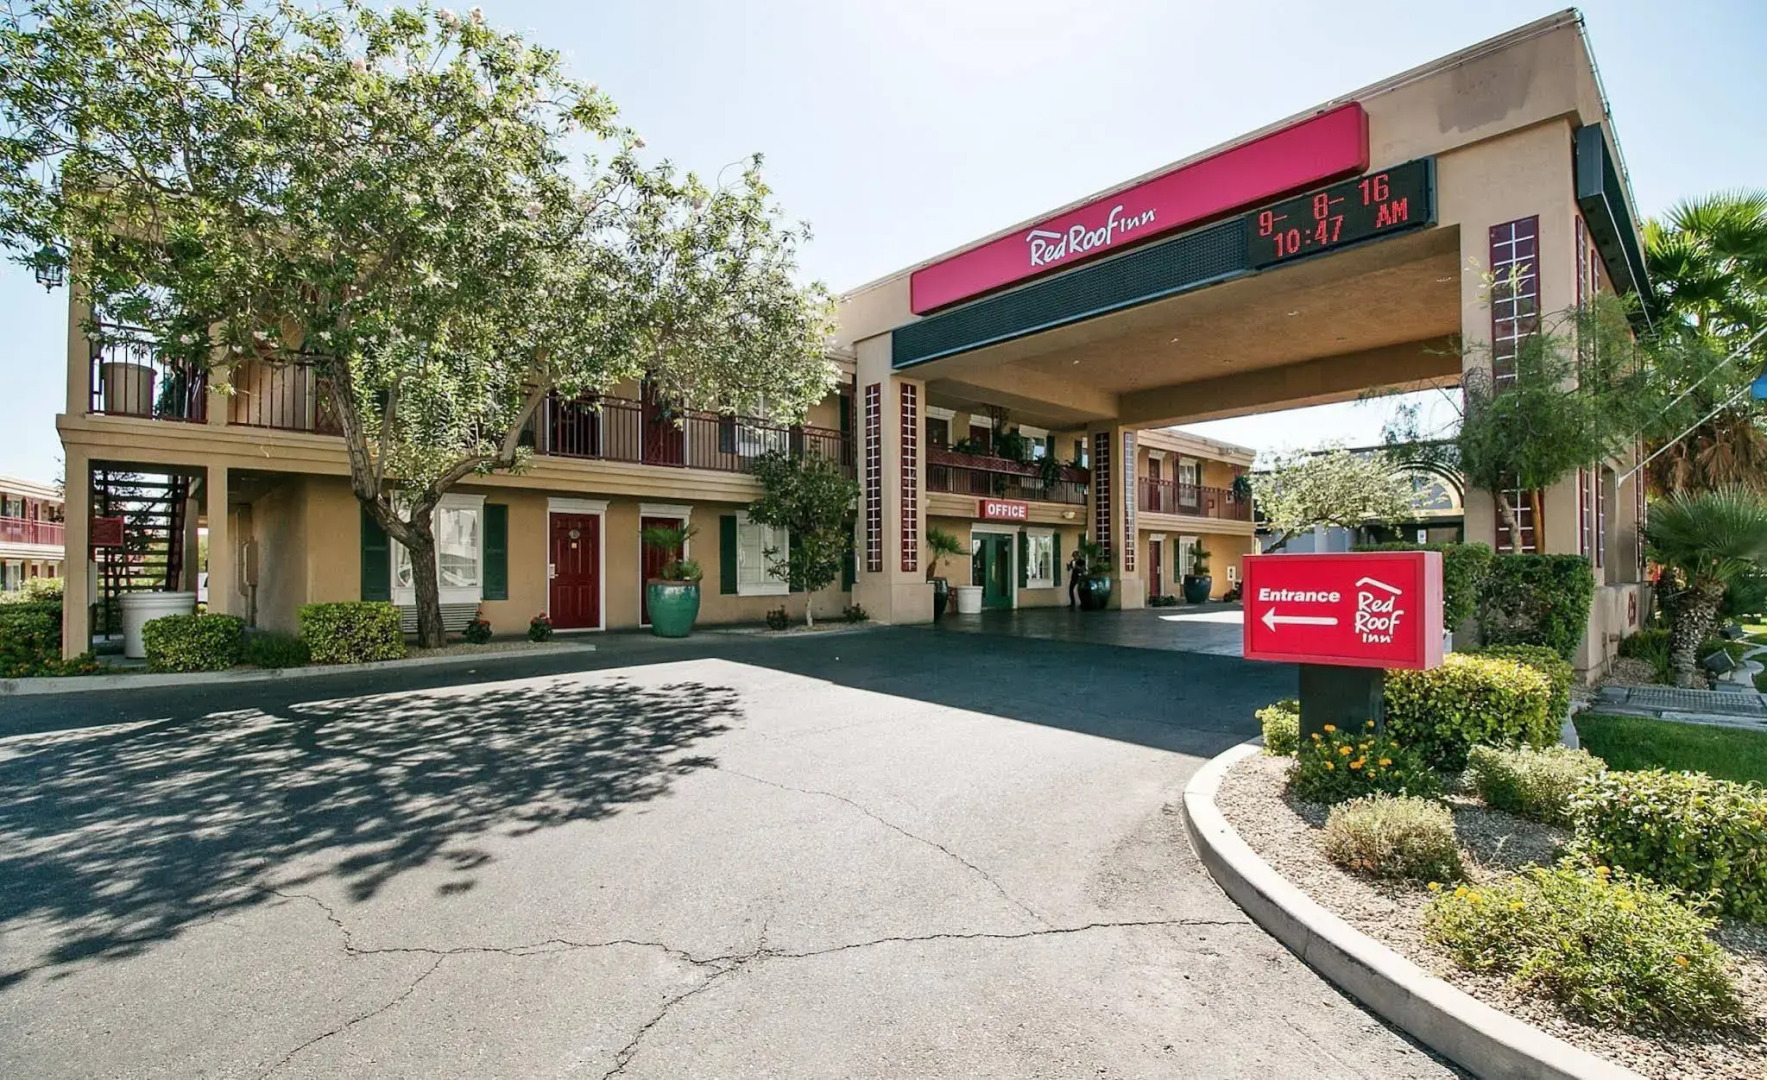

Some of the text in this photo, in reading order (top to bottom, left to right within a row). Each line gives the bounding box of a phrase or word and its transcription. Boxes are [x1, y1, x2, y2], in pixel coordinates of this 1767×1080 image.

[1358, 174, 1389, 206] 16
[1031, 234, 1067, 266] Red
[1069, 205, 1123, 253] Roof
[1273, 197, 1408, 258] 10:47 AM
[988, 503, 1025, 517] OFFICE
[1258, 588, 1341, 602] Entrance
[1358, 592, 1395, 613] Red
[1355, 610, 1404, 634] Roof
